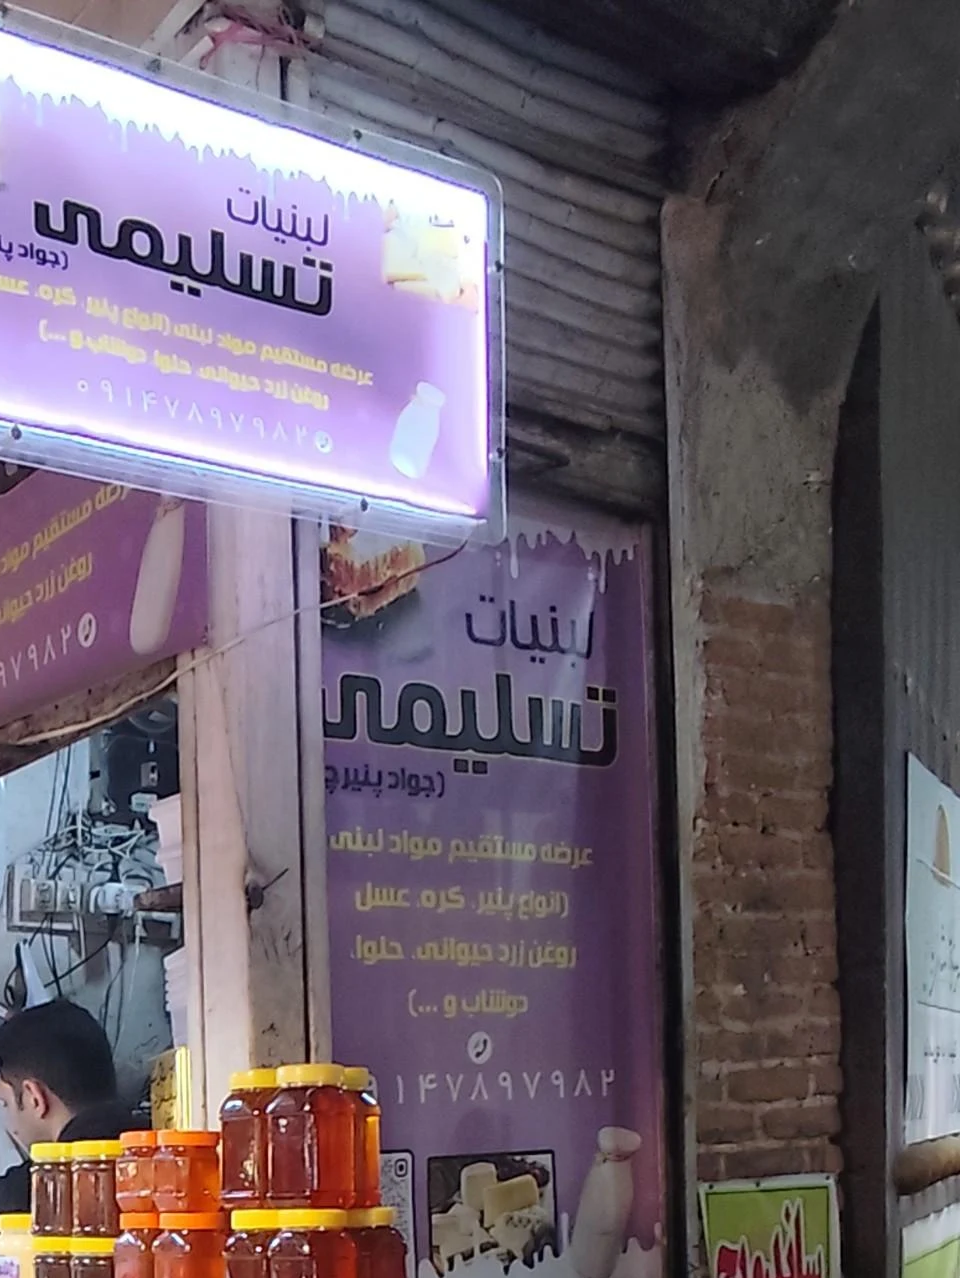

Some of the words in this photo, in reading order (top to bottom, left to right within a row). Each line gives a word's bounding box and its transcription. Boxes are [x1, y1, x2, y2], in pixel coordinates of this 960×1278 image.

[227, 187, 329, 250] لبنیات
[32, 197, 334, 316] تسلیمی
[465, 594, 595, 669] لبنیات
[322, 672, 618, 775] تسلیمی
[387, 766, 446, 798] (جواد
[329, 826, 384, 858] لبنی
[388, 829, 442, 860] مواد
[448, 834, 538, 864] مستقیم
[540, 840, 594, 869] عرضه
[354, 881, 411, 912] عسل
[527, 938, 577, 968] روغن
[443, 993, 457, 1019] و
